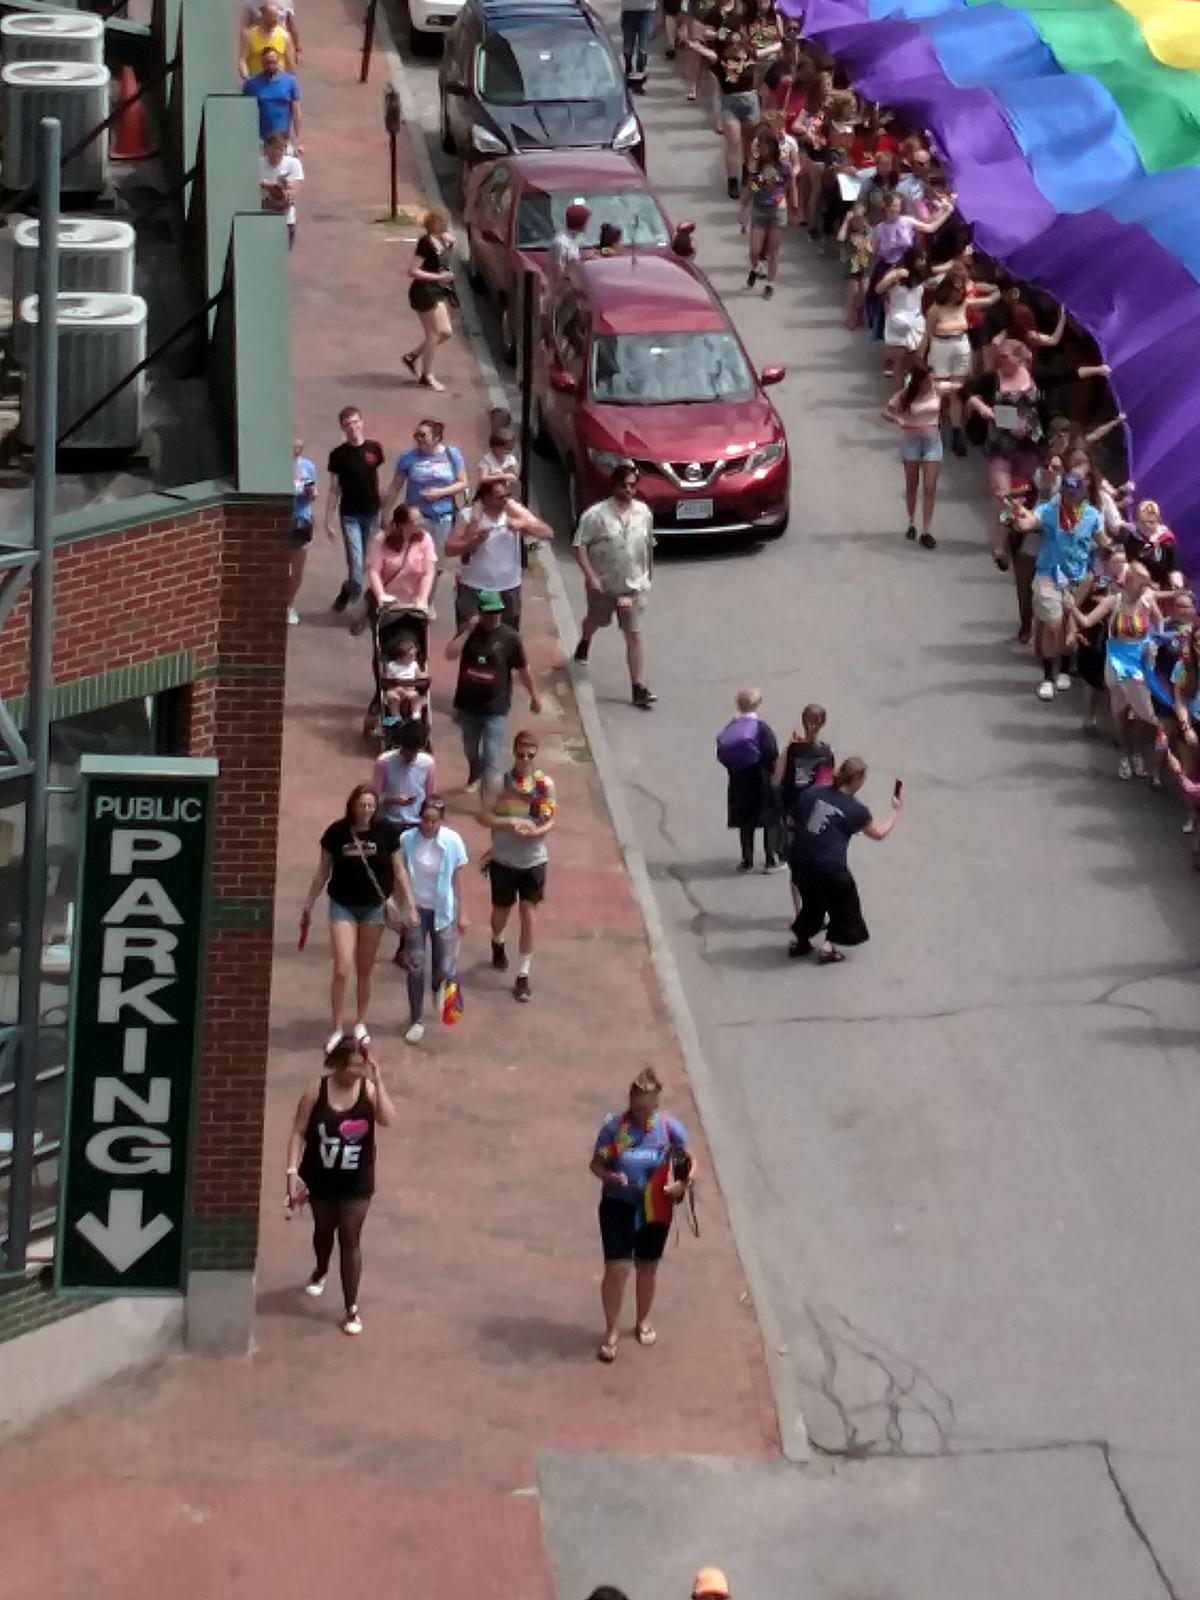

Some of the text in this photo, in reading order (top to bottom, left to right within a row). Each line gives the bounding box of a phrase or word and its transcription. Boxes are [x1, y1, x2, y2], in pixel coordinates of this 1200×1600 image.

[95, 795, 201, 823] PUBLIC
[84, 828, 185, 1175] PARKING
[320, 1144, 362, 1170] VE
